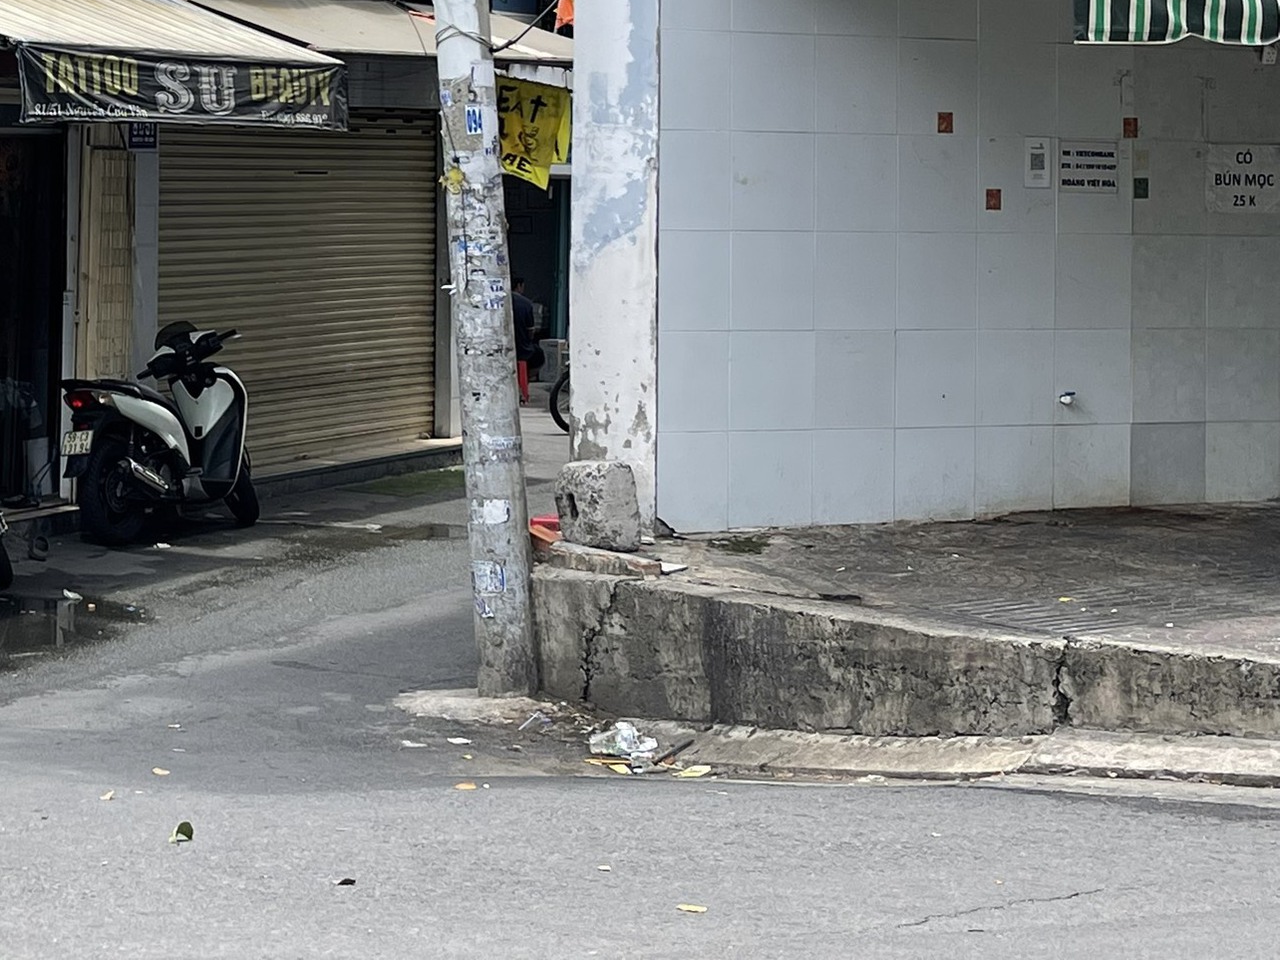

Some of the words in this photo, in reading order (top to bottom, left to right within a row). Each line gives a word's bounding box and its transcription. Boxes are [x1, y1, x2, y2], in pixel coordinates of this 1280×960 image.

[40, 51, 139, 97] TATTOO
[154, 59, 239, 116] SU
[249, 66, 331, 107] BEAUTY
[1235, 148, 1253, 165] CÓ
[1214, 170, 1241, 186] BÚN
[1244, 173, 1274, 189] MỌC
[1233, 194, 1246, 207] 25
[1248, 194, 1257, 207] K
